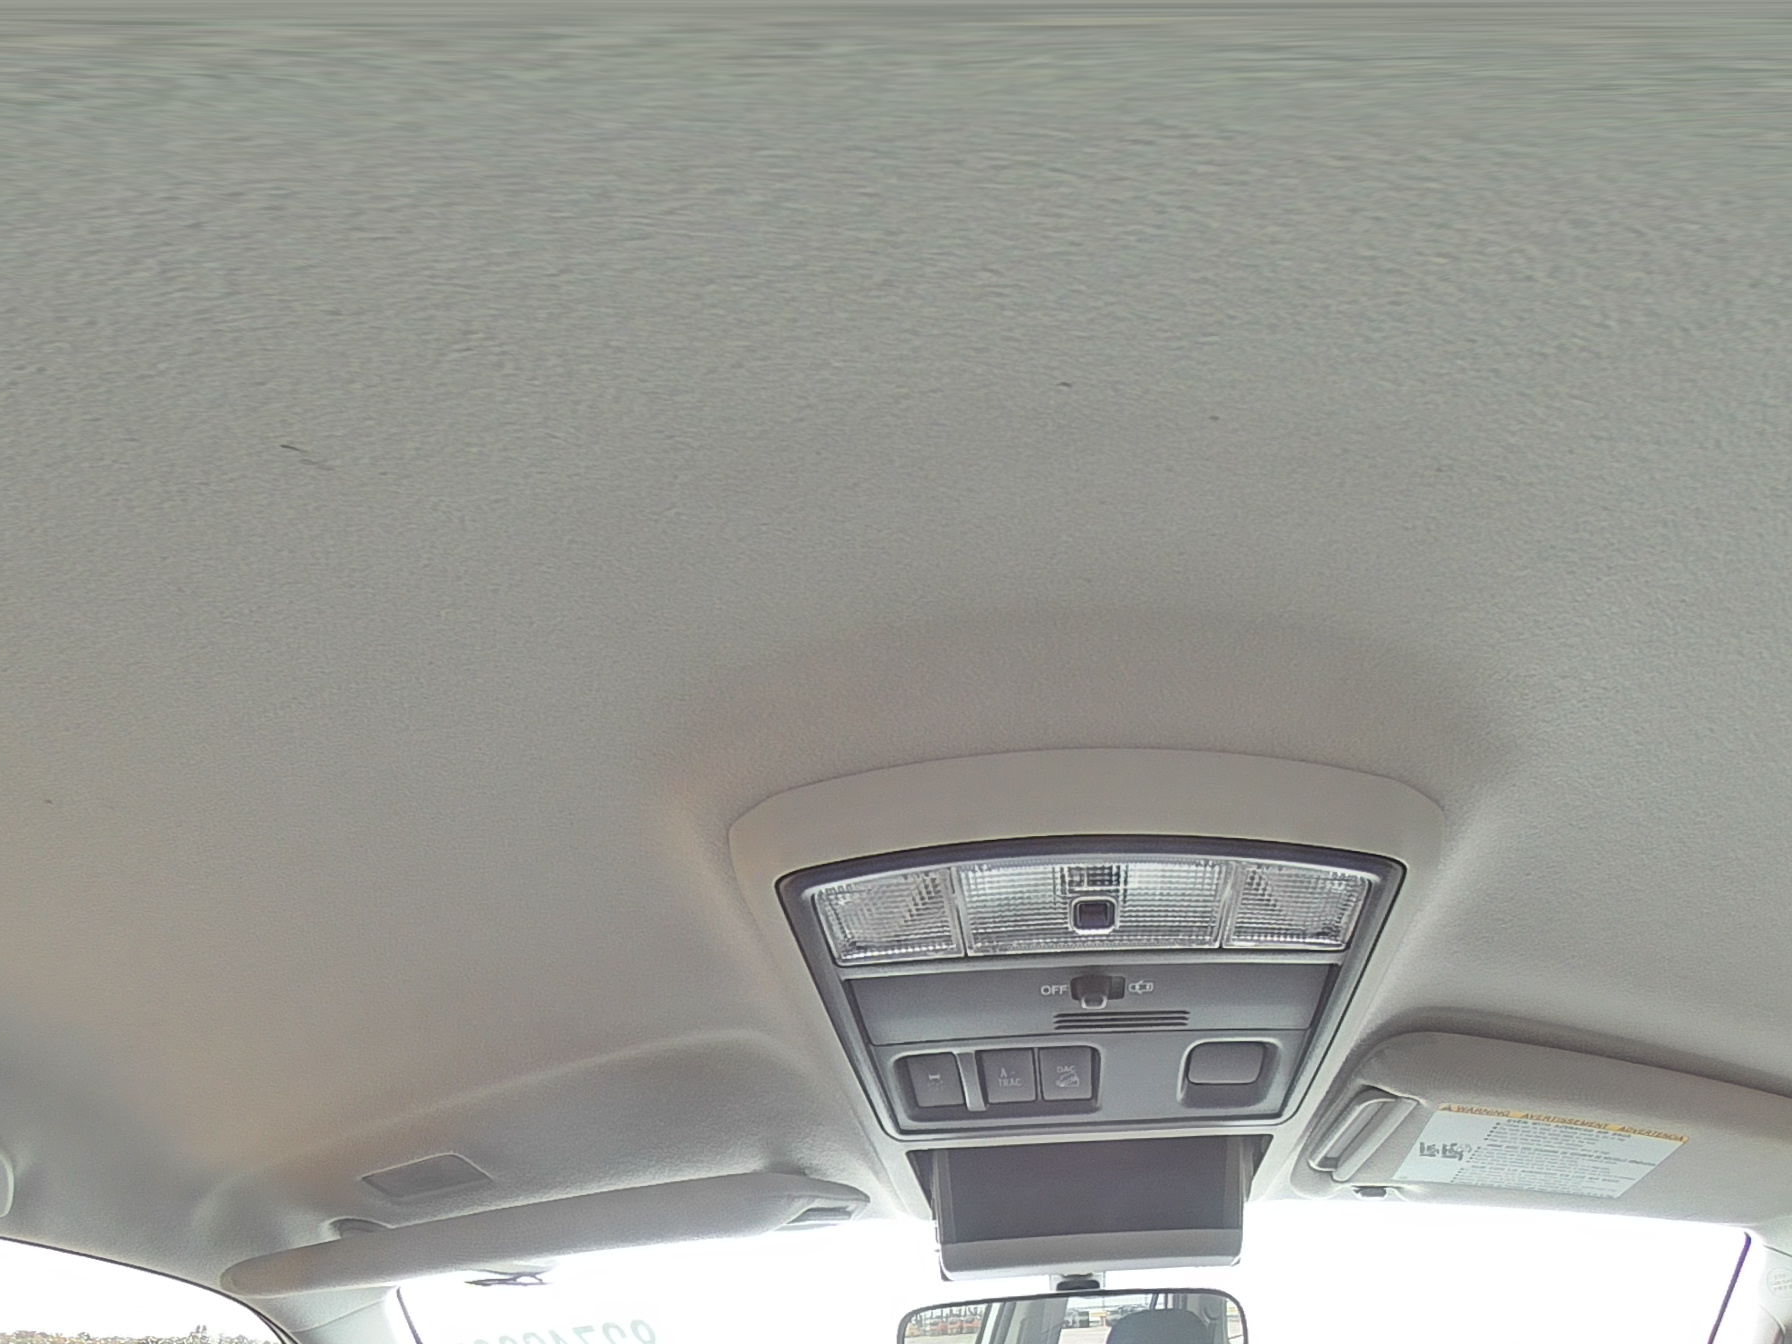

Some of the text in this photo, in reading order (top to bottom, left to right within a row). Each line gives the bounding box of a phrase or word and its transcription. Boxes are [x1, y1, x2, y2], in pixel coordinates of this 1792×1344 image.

[1041, 984, 1068, 996] OFF
[1057, 1065, 1076, 1073] DAC
[1456, 1105, 1511, 1117] WARNING
[1521, 1112, 1609, 1129] AVERTISSEMENT
